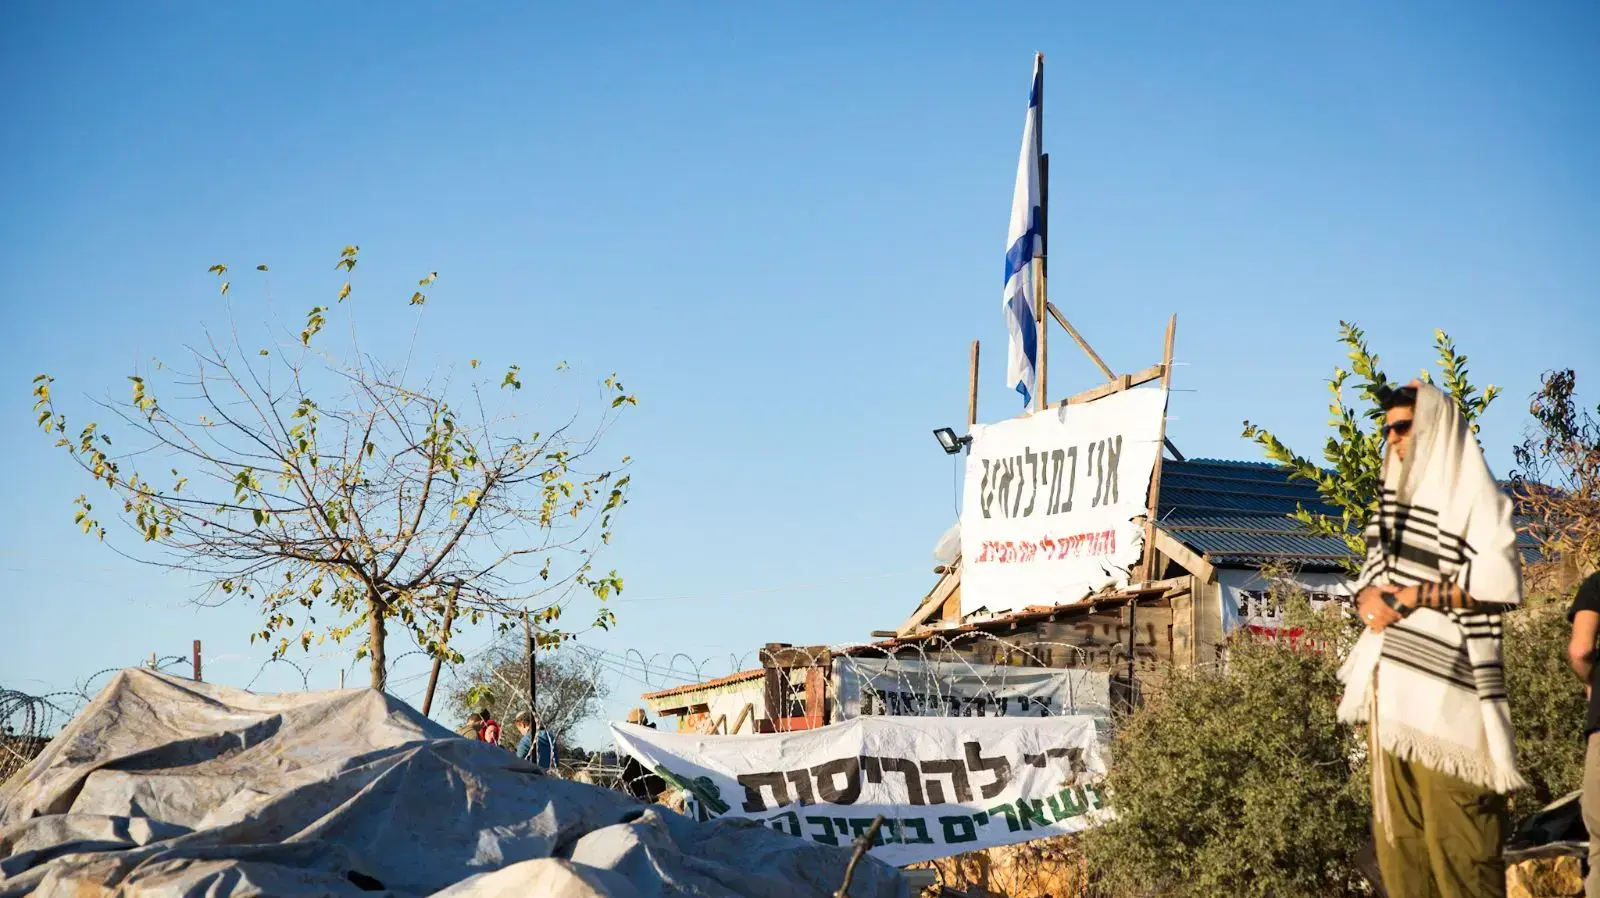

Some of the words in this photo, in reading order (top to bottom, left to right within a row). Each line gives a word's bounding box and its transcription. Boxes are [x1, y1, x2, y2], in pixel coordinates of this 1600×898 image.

[1087, 434, 1122, 508] אני
[737, 741, 1012, 812] להריסות
[1023, 747, 1088, 780] די
[805, 815, 935, 847] בנתיב
